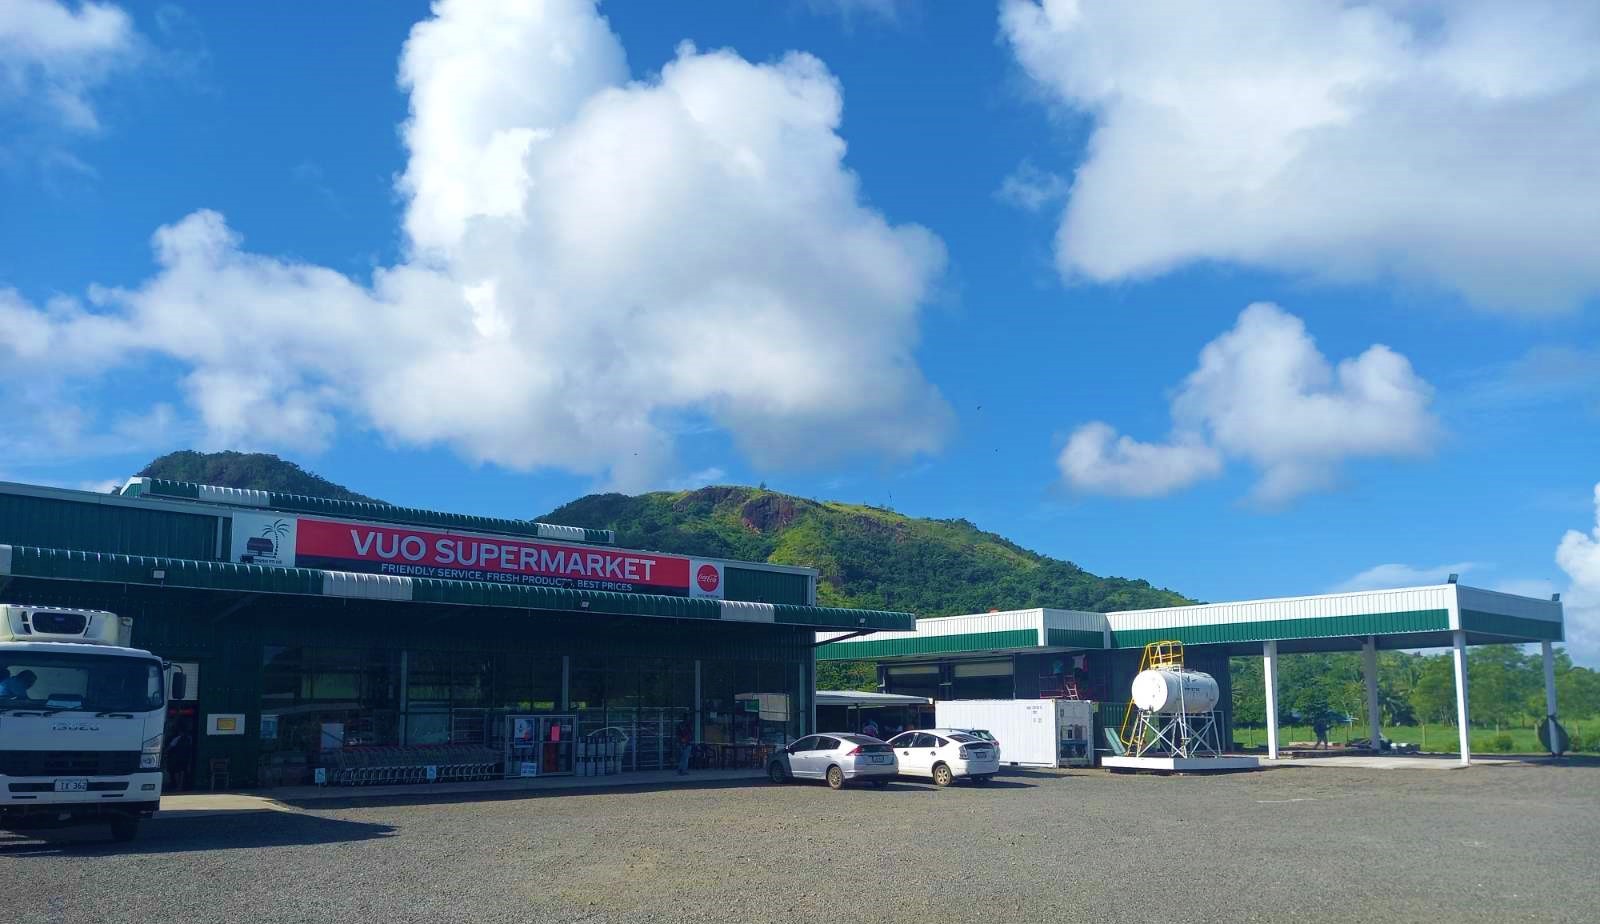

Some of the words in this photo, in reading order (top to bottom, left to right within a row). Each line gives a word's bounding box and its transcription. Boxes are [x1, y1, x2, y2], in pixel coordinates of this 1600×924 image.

[350, 529, 426, 561] VUO
[434, 539, 656, 581] SUPERMARKET
[381, 563, 435, 577] FRIENDLY
[437, 568, 485, 581] SERVICE,
[487, 572, 520, 583] FRESH
[577, 579, 600, 589] BEST
[601, 582, 633, 592] PRICES
